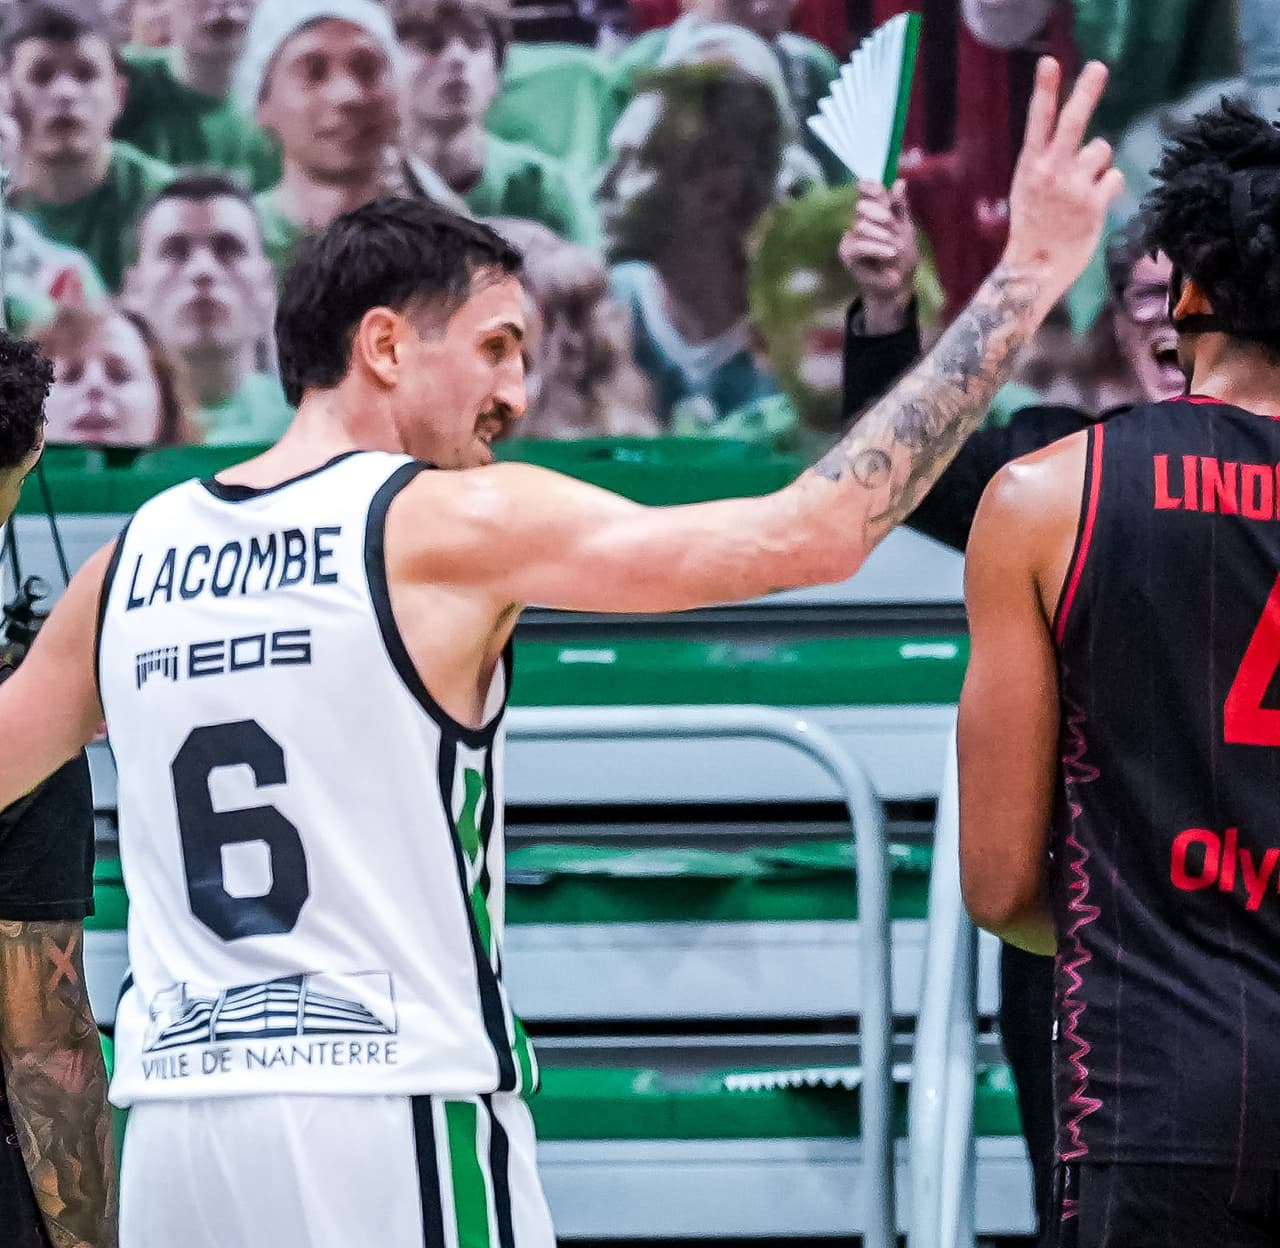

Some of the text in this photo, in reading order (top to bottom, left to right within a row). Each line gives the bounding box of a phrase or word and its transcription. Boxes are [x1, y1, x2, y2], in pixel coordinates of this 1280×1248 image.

[1153, 454, 1280, 521] LIND
[126, 526, 342, 612] LACOMBE
[170, 718, 310, 944] 6
[1171, 827, 1280, 911] Oly
[142, 1040, 398, 1081] VILLE DE NANTERRE
